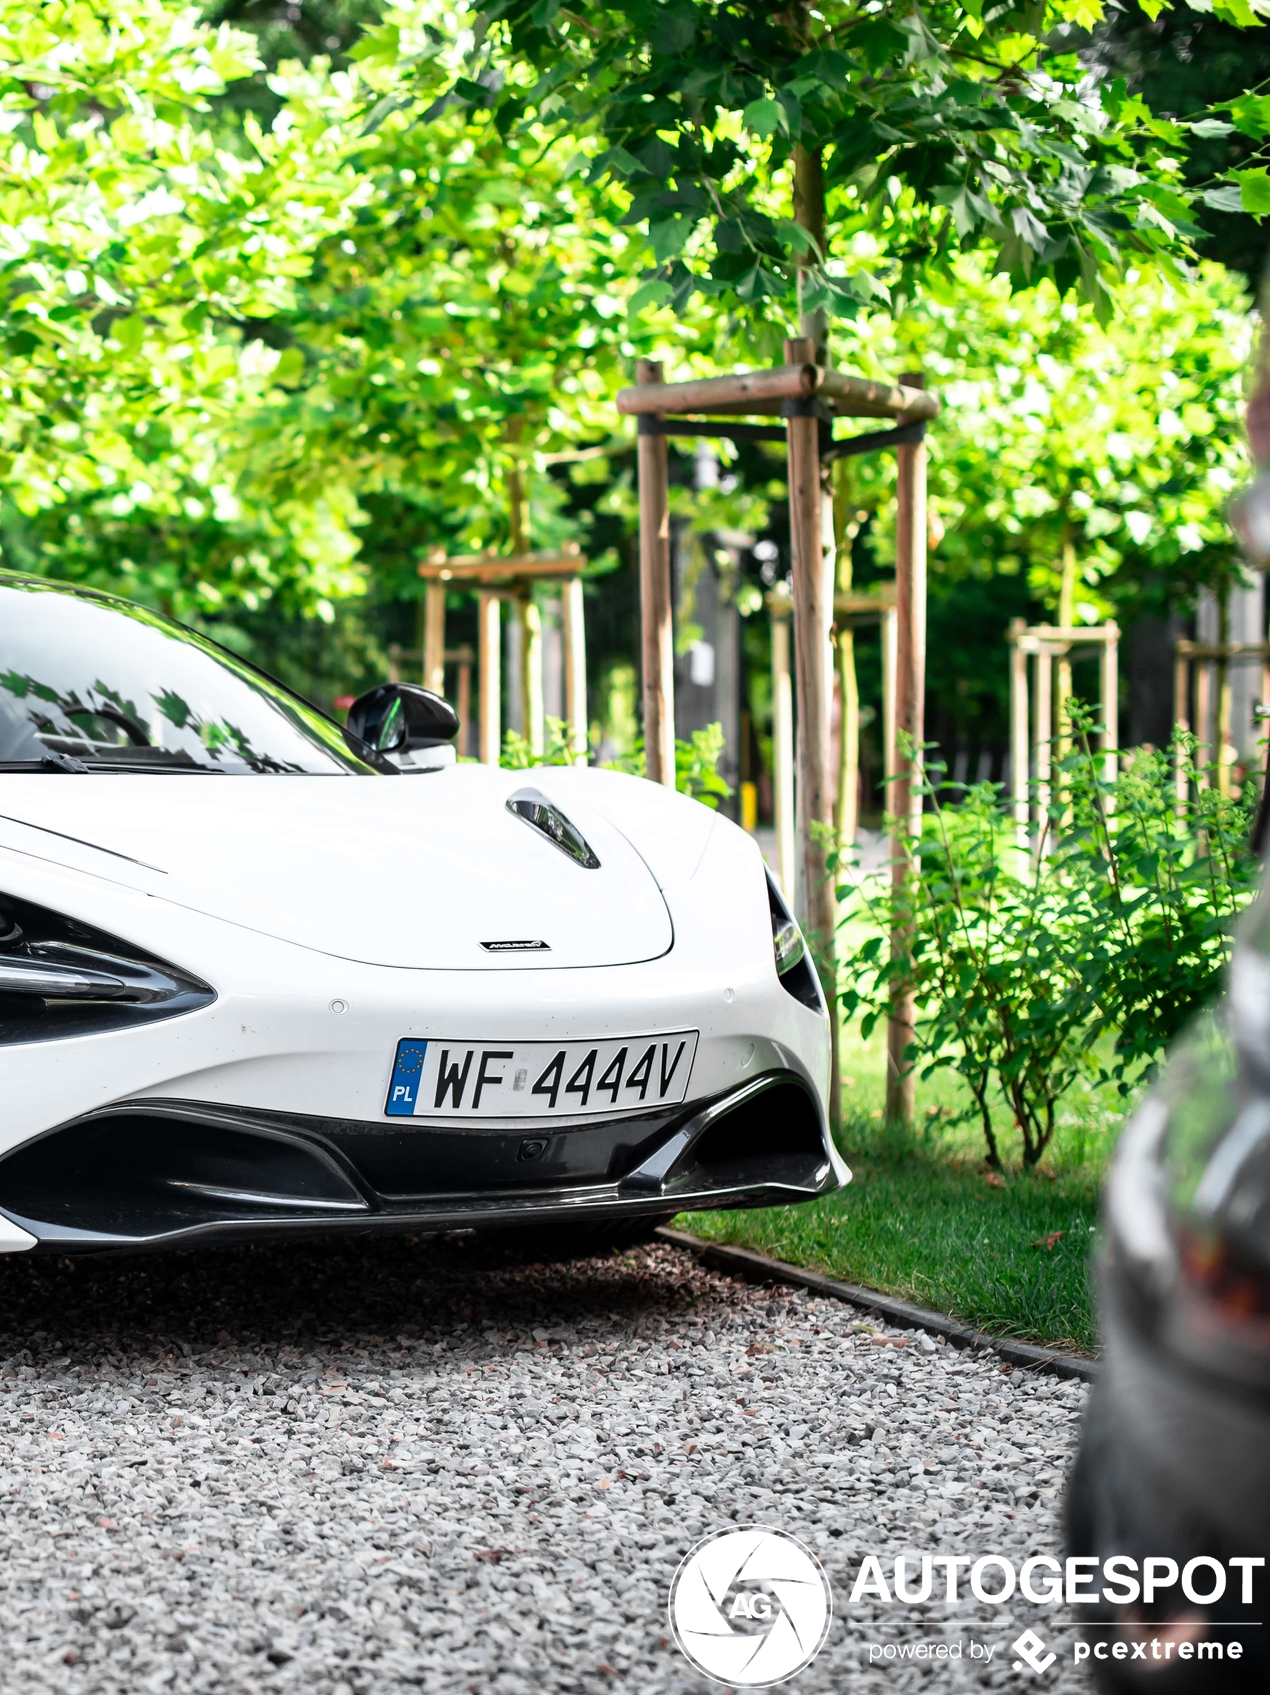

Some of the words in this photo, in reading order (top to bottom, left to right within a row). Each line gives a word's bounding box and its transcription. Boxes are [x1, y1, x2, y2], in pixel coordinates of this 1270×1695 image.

[392, 1085, 413, 1102] PL
[433, 1049, 514, 1109] WF
[531, 1040, 687, 1108] 4444V
